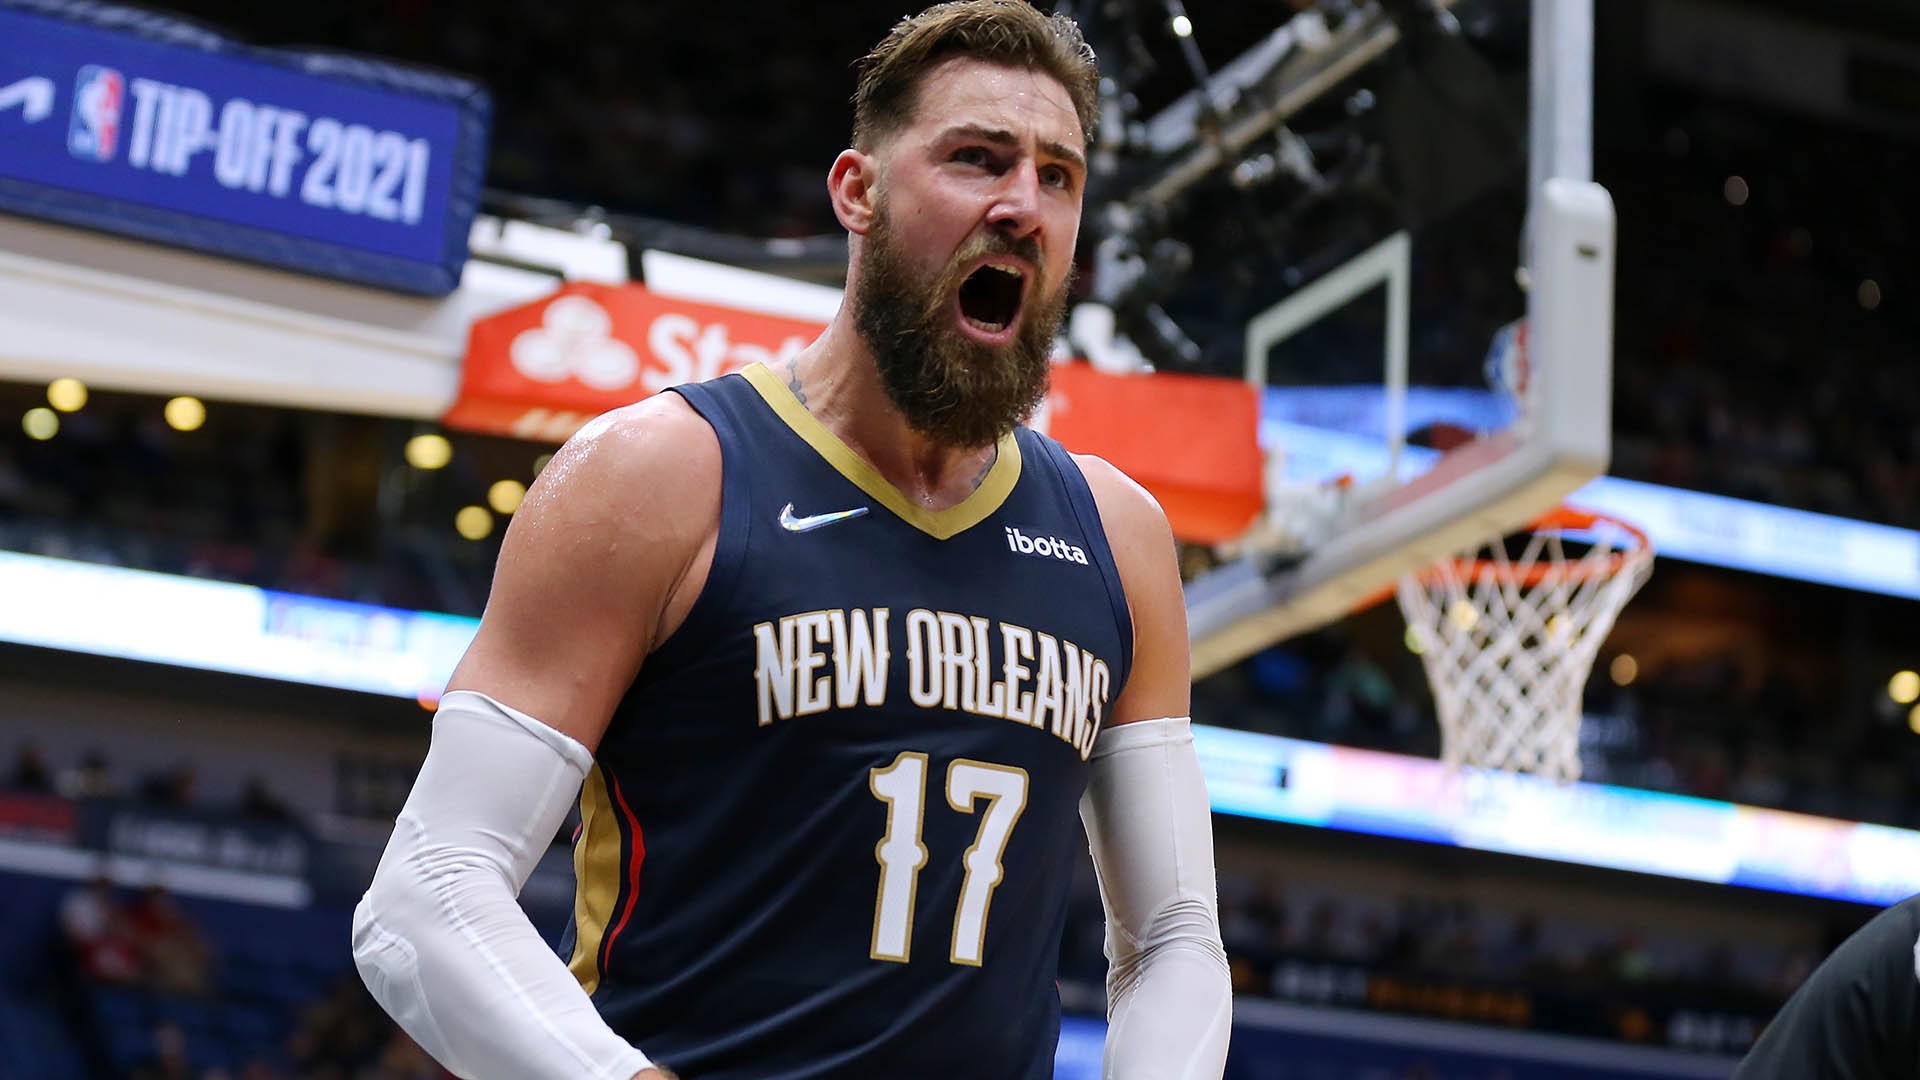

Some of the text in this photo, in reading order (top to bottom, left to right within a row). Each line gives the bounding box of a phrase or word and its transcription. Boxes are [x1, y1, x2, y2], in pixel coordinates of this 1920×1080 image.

[129, 77, 430, 225] TIP-OFF 2021
[1005, 526, 1088, 565] ibotta
[754, 608, 1110, 761] NEW ORLEANS
[869, 751, 1030, 967] 17
